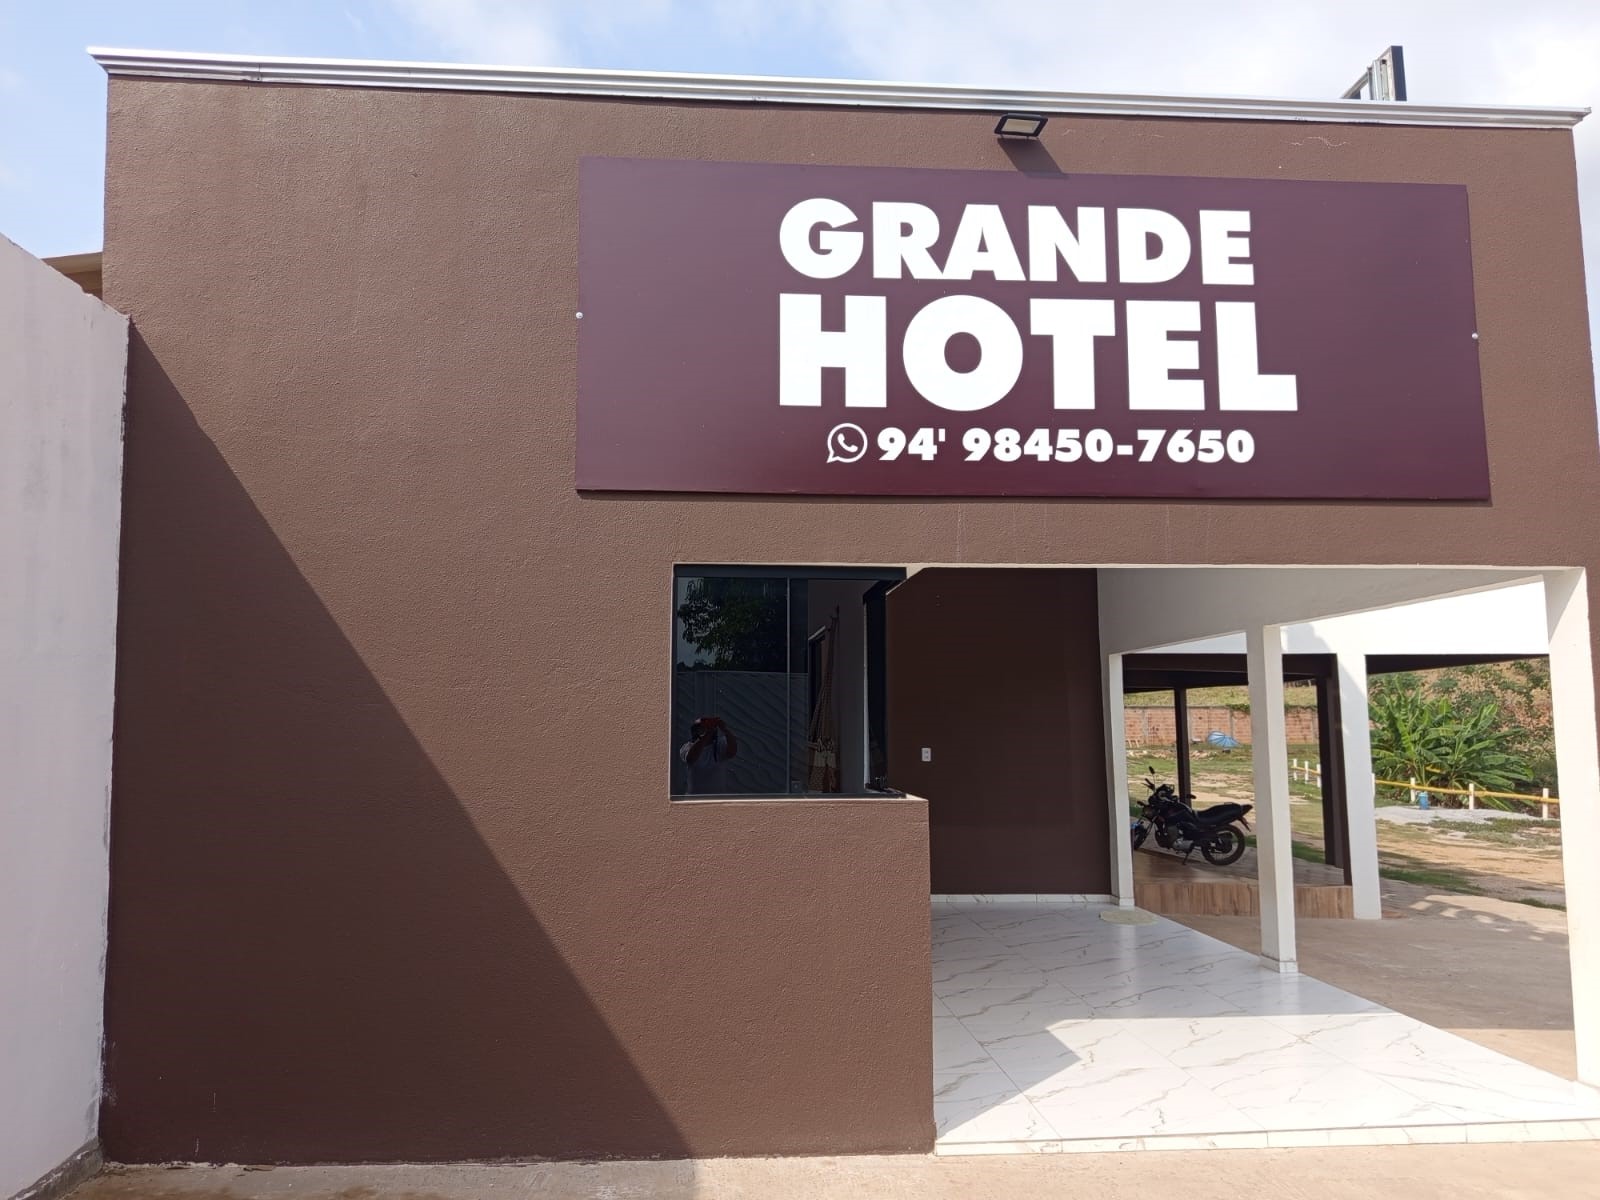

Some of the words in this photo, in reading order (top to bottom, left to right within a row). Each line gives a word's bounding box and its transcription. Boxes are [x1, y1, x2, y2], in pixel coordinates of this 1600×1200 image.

[779, 197, 1255, 286] GRANDE
[779, 293, 1298, 412] HOTEL
[963, 427, 1255, 464] 98450-7650
